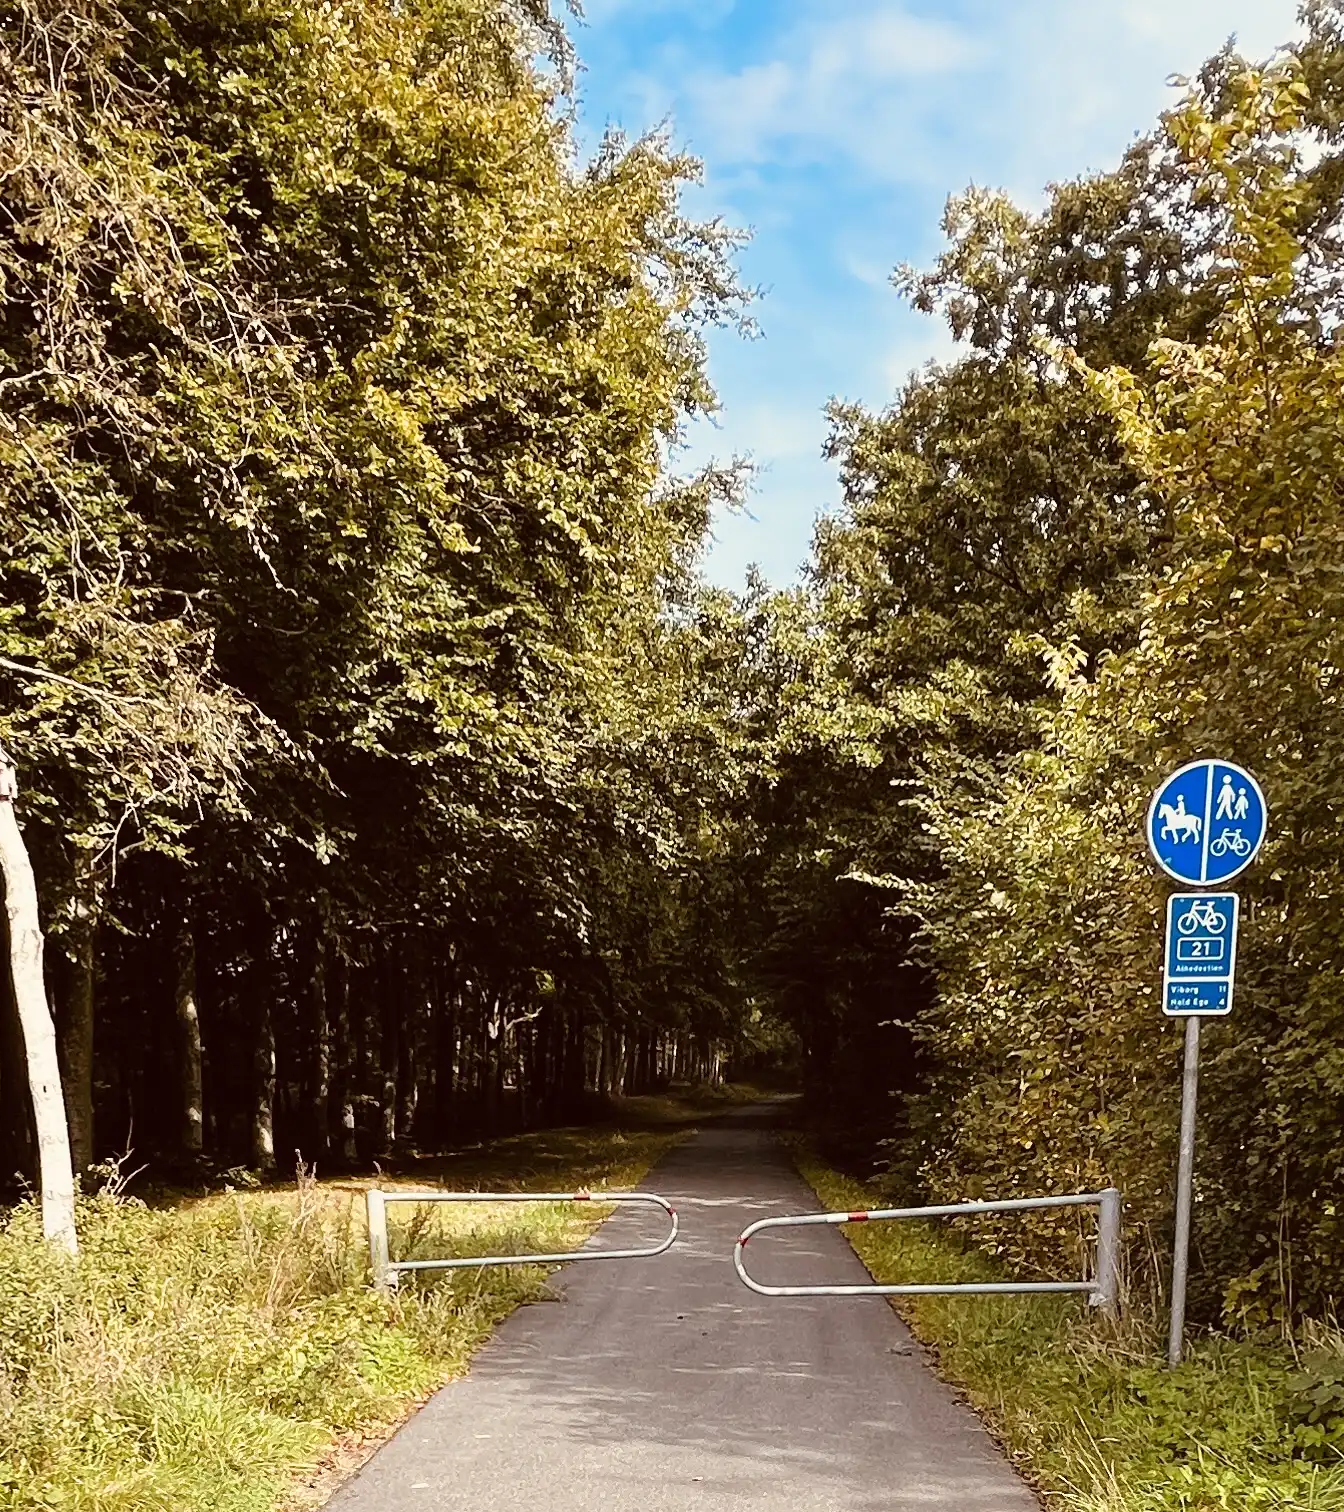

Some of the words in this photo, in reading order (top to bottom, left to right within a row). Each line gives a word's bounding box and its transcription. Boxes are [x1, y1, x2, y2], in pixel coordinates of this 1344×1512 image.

[1191, 941, 1211, 956] 21
[1170, 986, 1199, 994] Viborg
[1218, 998, 1225, 1006] 4
